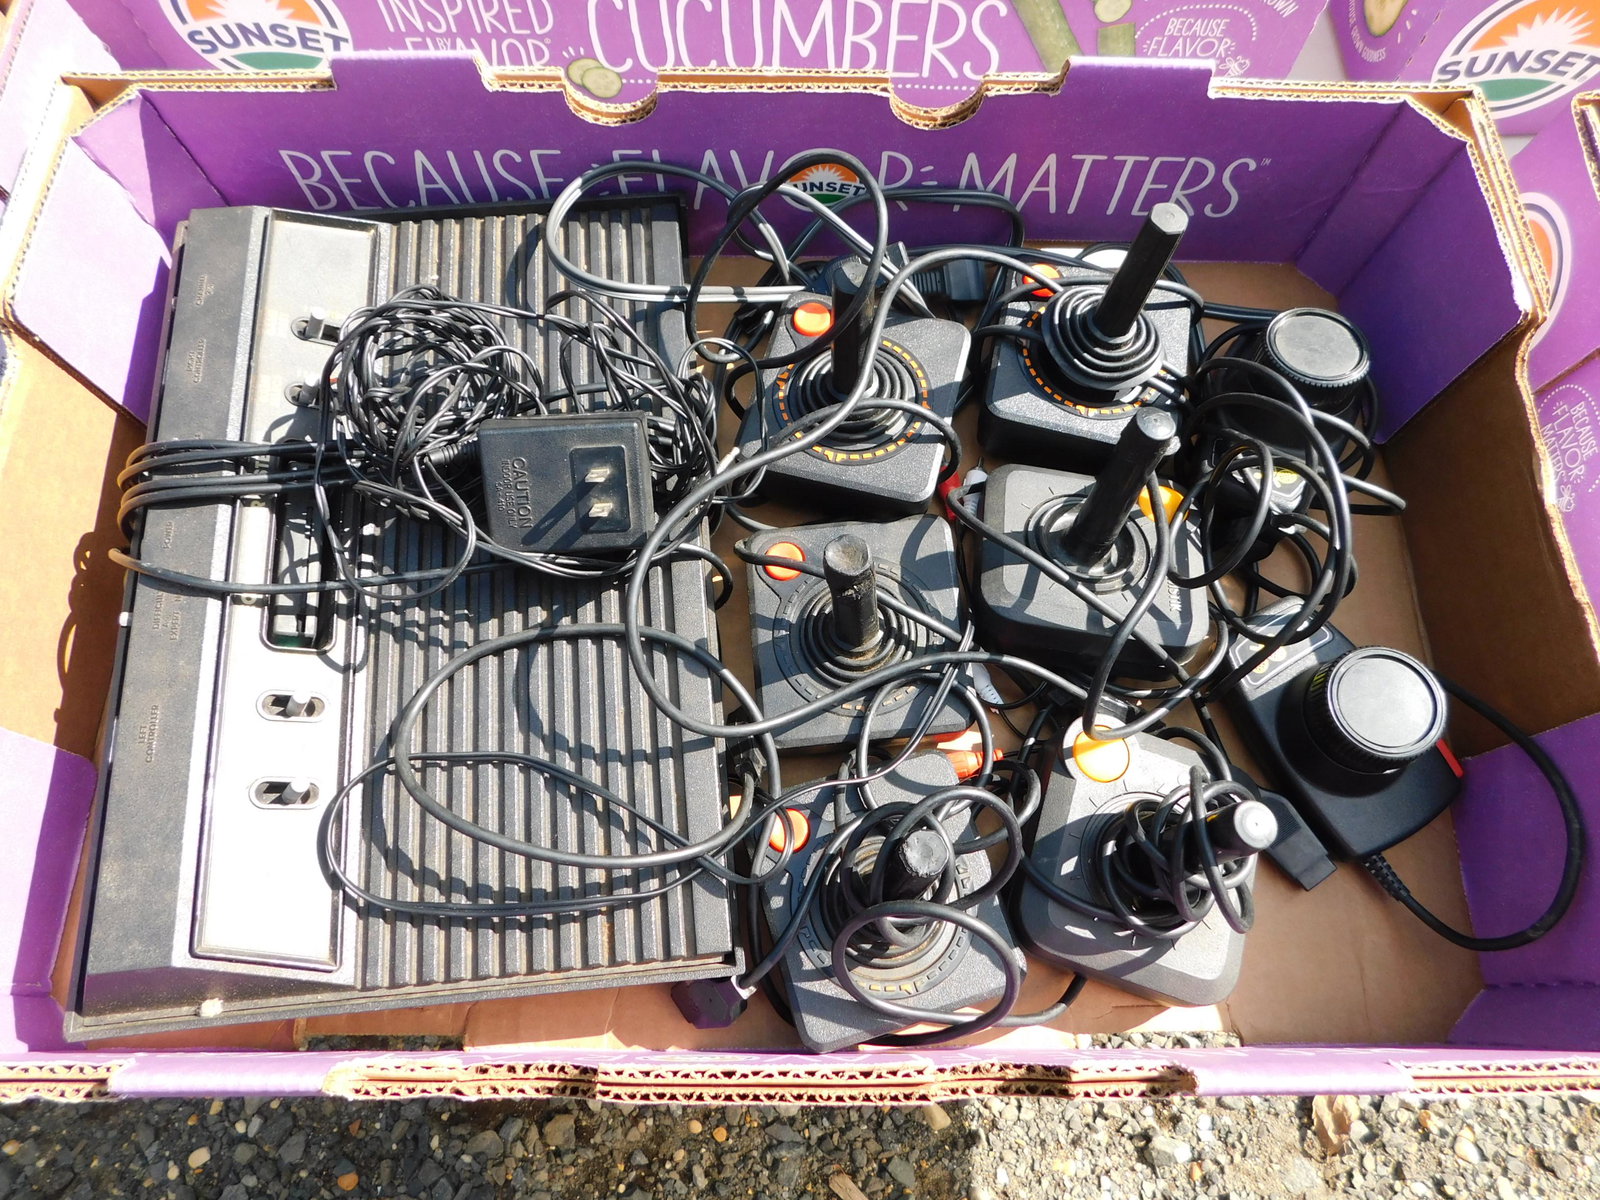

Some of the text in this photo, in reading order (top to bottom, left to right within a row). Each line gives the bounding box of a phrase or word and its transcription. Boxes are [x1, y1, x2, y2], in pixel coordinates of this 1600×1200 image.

[376, 0, 554, 34] INSPIRED
[1164, 18, 1231, 38] BECAUSE
[187, 22, 349, 55] SUNSET
[587, 0, 1008, 80] CUCUMBERS
[1147, 37, 1231, 58] FLAVOR
[1434, 49, 1600, 84] SUNSET
[279, 149, 564, 211] BECAUSE
[792, 181, 866, 196] UNSET
[1552, 404, 1585, 481] FLAVOR
[1570, 401, 1599, 461] BECAUSE
[501, 459, 519, 529] INDOOR USE ONLY
[511, 456, 534, 530] CAUTION
[153, 592, 165, 631] DIFFICUL
[169, 610, 182, 642] EXPERT
[137, 725, 147, 745] LEFT
[145, 704, 160, 764] CONTROLLER
